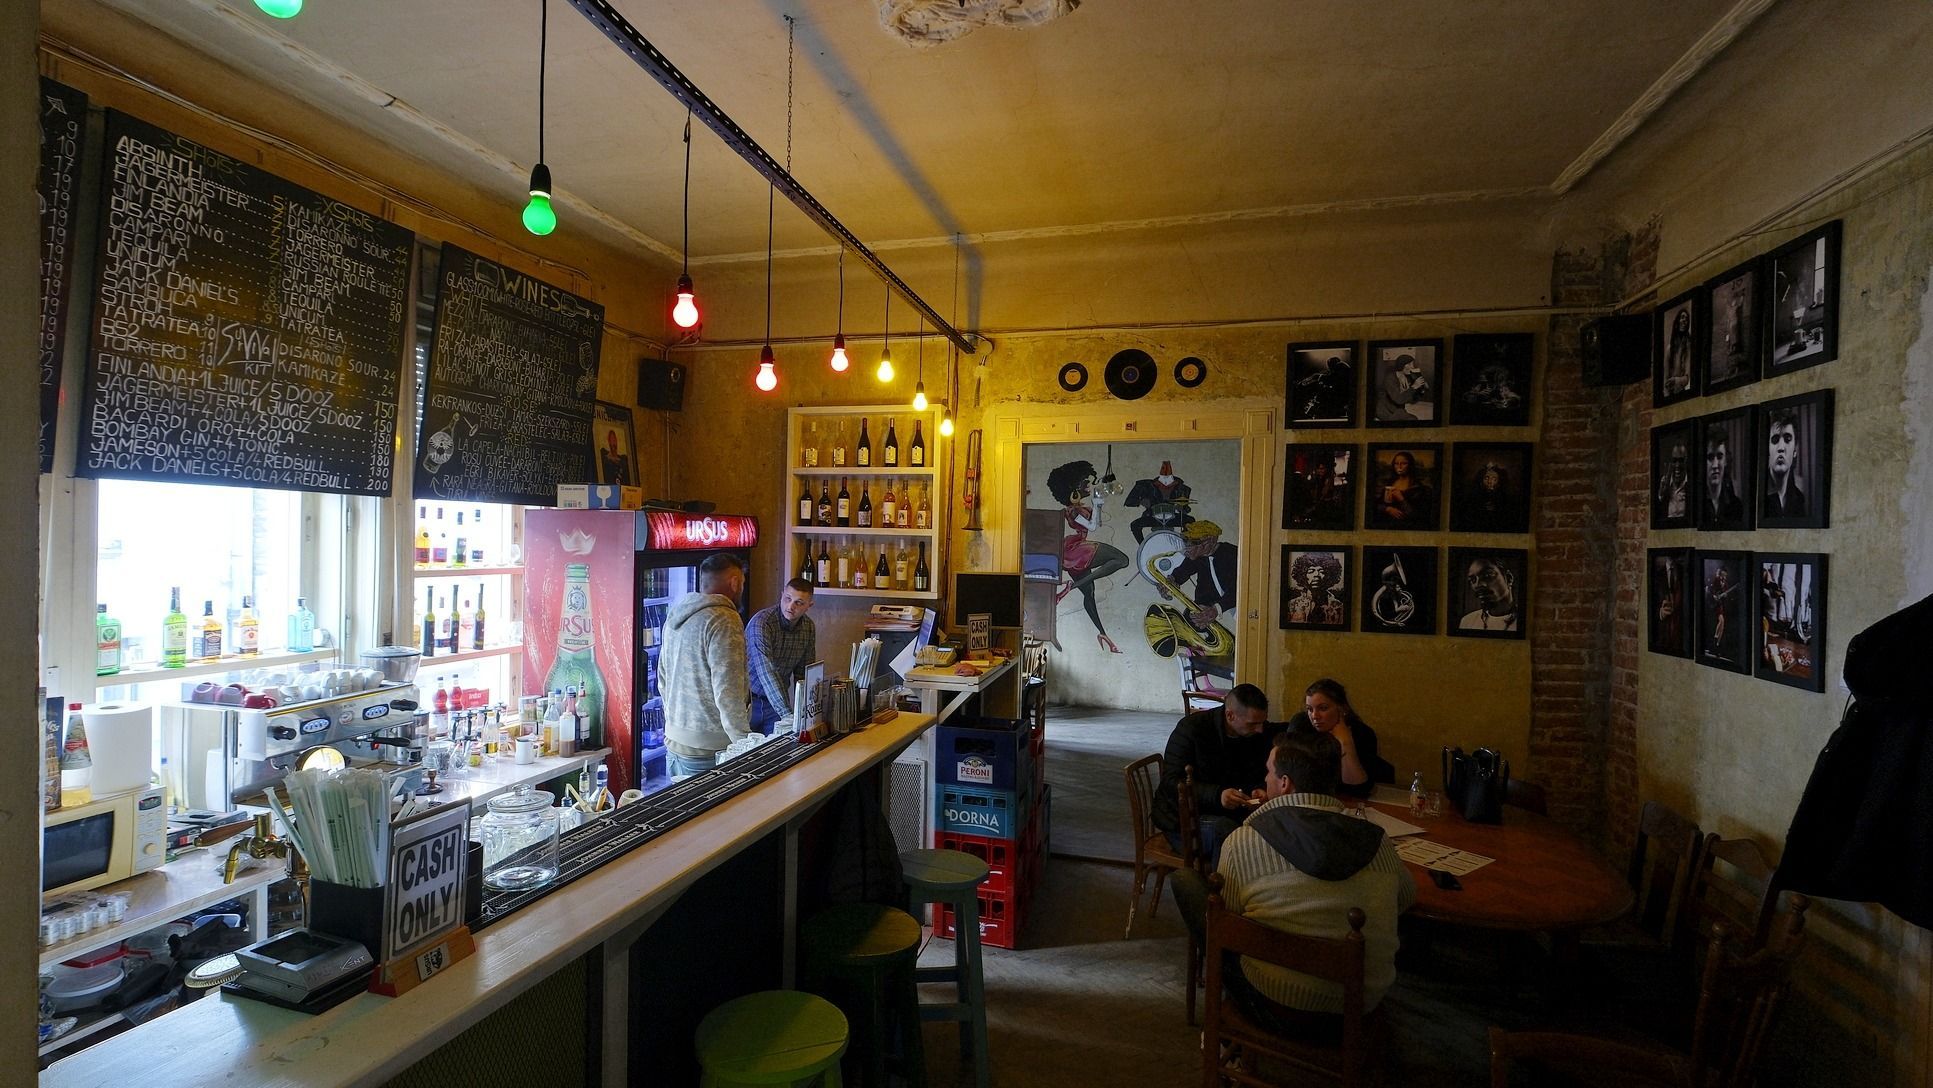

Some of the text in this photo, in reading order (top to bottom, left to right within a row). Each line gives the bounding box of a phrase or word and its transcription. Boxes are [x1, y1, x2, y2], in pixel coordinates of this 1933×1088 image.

[57, 135, 76, 157] 10
[66, 120, 78, 140] 9
[116, 135, 204, 180] ABSINTH
[51, 189, 70, 211] 19
[52, 172, 71, 193] 19
[113, 164, 210, 212] FINLANDIA
[49, 208, 68, 227] 19
[111, 195, 224, 243] DISARONNO
[113, 178, 144, 204] JIM
[151, 193, 204, 225] BEAM
[288, 200, 352, 236] KAMIKAZE
[47, 226, 66, 245] 19
[108, 224, 189, 263] TEQUILA
[110, 210, 191, 248] CAMPARI
[286, 225, 344, 256] TORRERO
[287, 214, 358, 249] DISARONNO
[362, 241, 390, 263] SOUR
[46, 243, 64, 262] 19
[107, 238, 177, 274] UNICUM
[43, 277, 61, 297] 19
[103, 270, 199, 309] SAMBUCA
[105, 257, 161, 286] JACK
[166, 270, 240, 306] DANIEL'S
[283, 264, 402, 314] JIM BEAM 50
[284, 252, 340, 280] RUSSIAN
[391, 288, 404, 301] 50
[500, 268, 561, 312] WINES
[41, 295, 60, 315] 19
[100, 286, 173, 317] STROH
[279, 302, 326, 327] UNICUM
[280, 289, 335, 317] TEQUILA
[281, 278, 401, 324] CAMPARI 50
[40, 314, 57, 333] 19
[100, 301, 216, 340] TATRATEA 10
[278, 314, 345, 345] TATRATEA
[100, 332, 188, 360] TORRERO
[278, 342, 396, 383] DISARONO SOUR 24
[244, 362, 273, 376] KIT
[277, 358, 394, 398] KAMIKAZE 24
[95, 388, 131, 407] JIM
[372, 431, 392, 445] 150
[286, 384, 335, 409] DOOZ
[373, 400, 395, 419] 150
[92, 404, 188, 430] BACARDI
[371, 442, 391, 456] 150
[372, 418, 393, 434] 150
[91, 420, 174, 441] BOMBAY
[180, 429, 211, 447] GIN
[370, 454, 390, 468] 180
[88, 450, 143, 471] JACK
[366, 478, 389, 491] 200
[686, 516, 729, 546] URSUS
[561, 614, 595, 637] RSU
[972, 621, 987, 633] CASH
[972, 636, 987, 648] ONLY
[961, 767, 990, 777] PERONI
[950, 808, 999, 827] DORNA
[401, 831, 456, 892] CASH
[399, 881, 454, 945] ONLY
